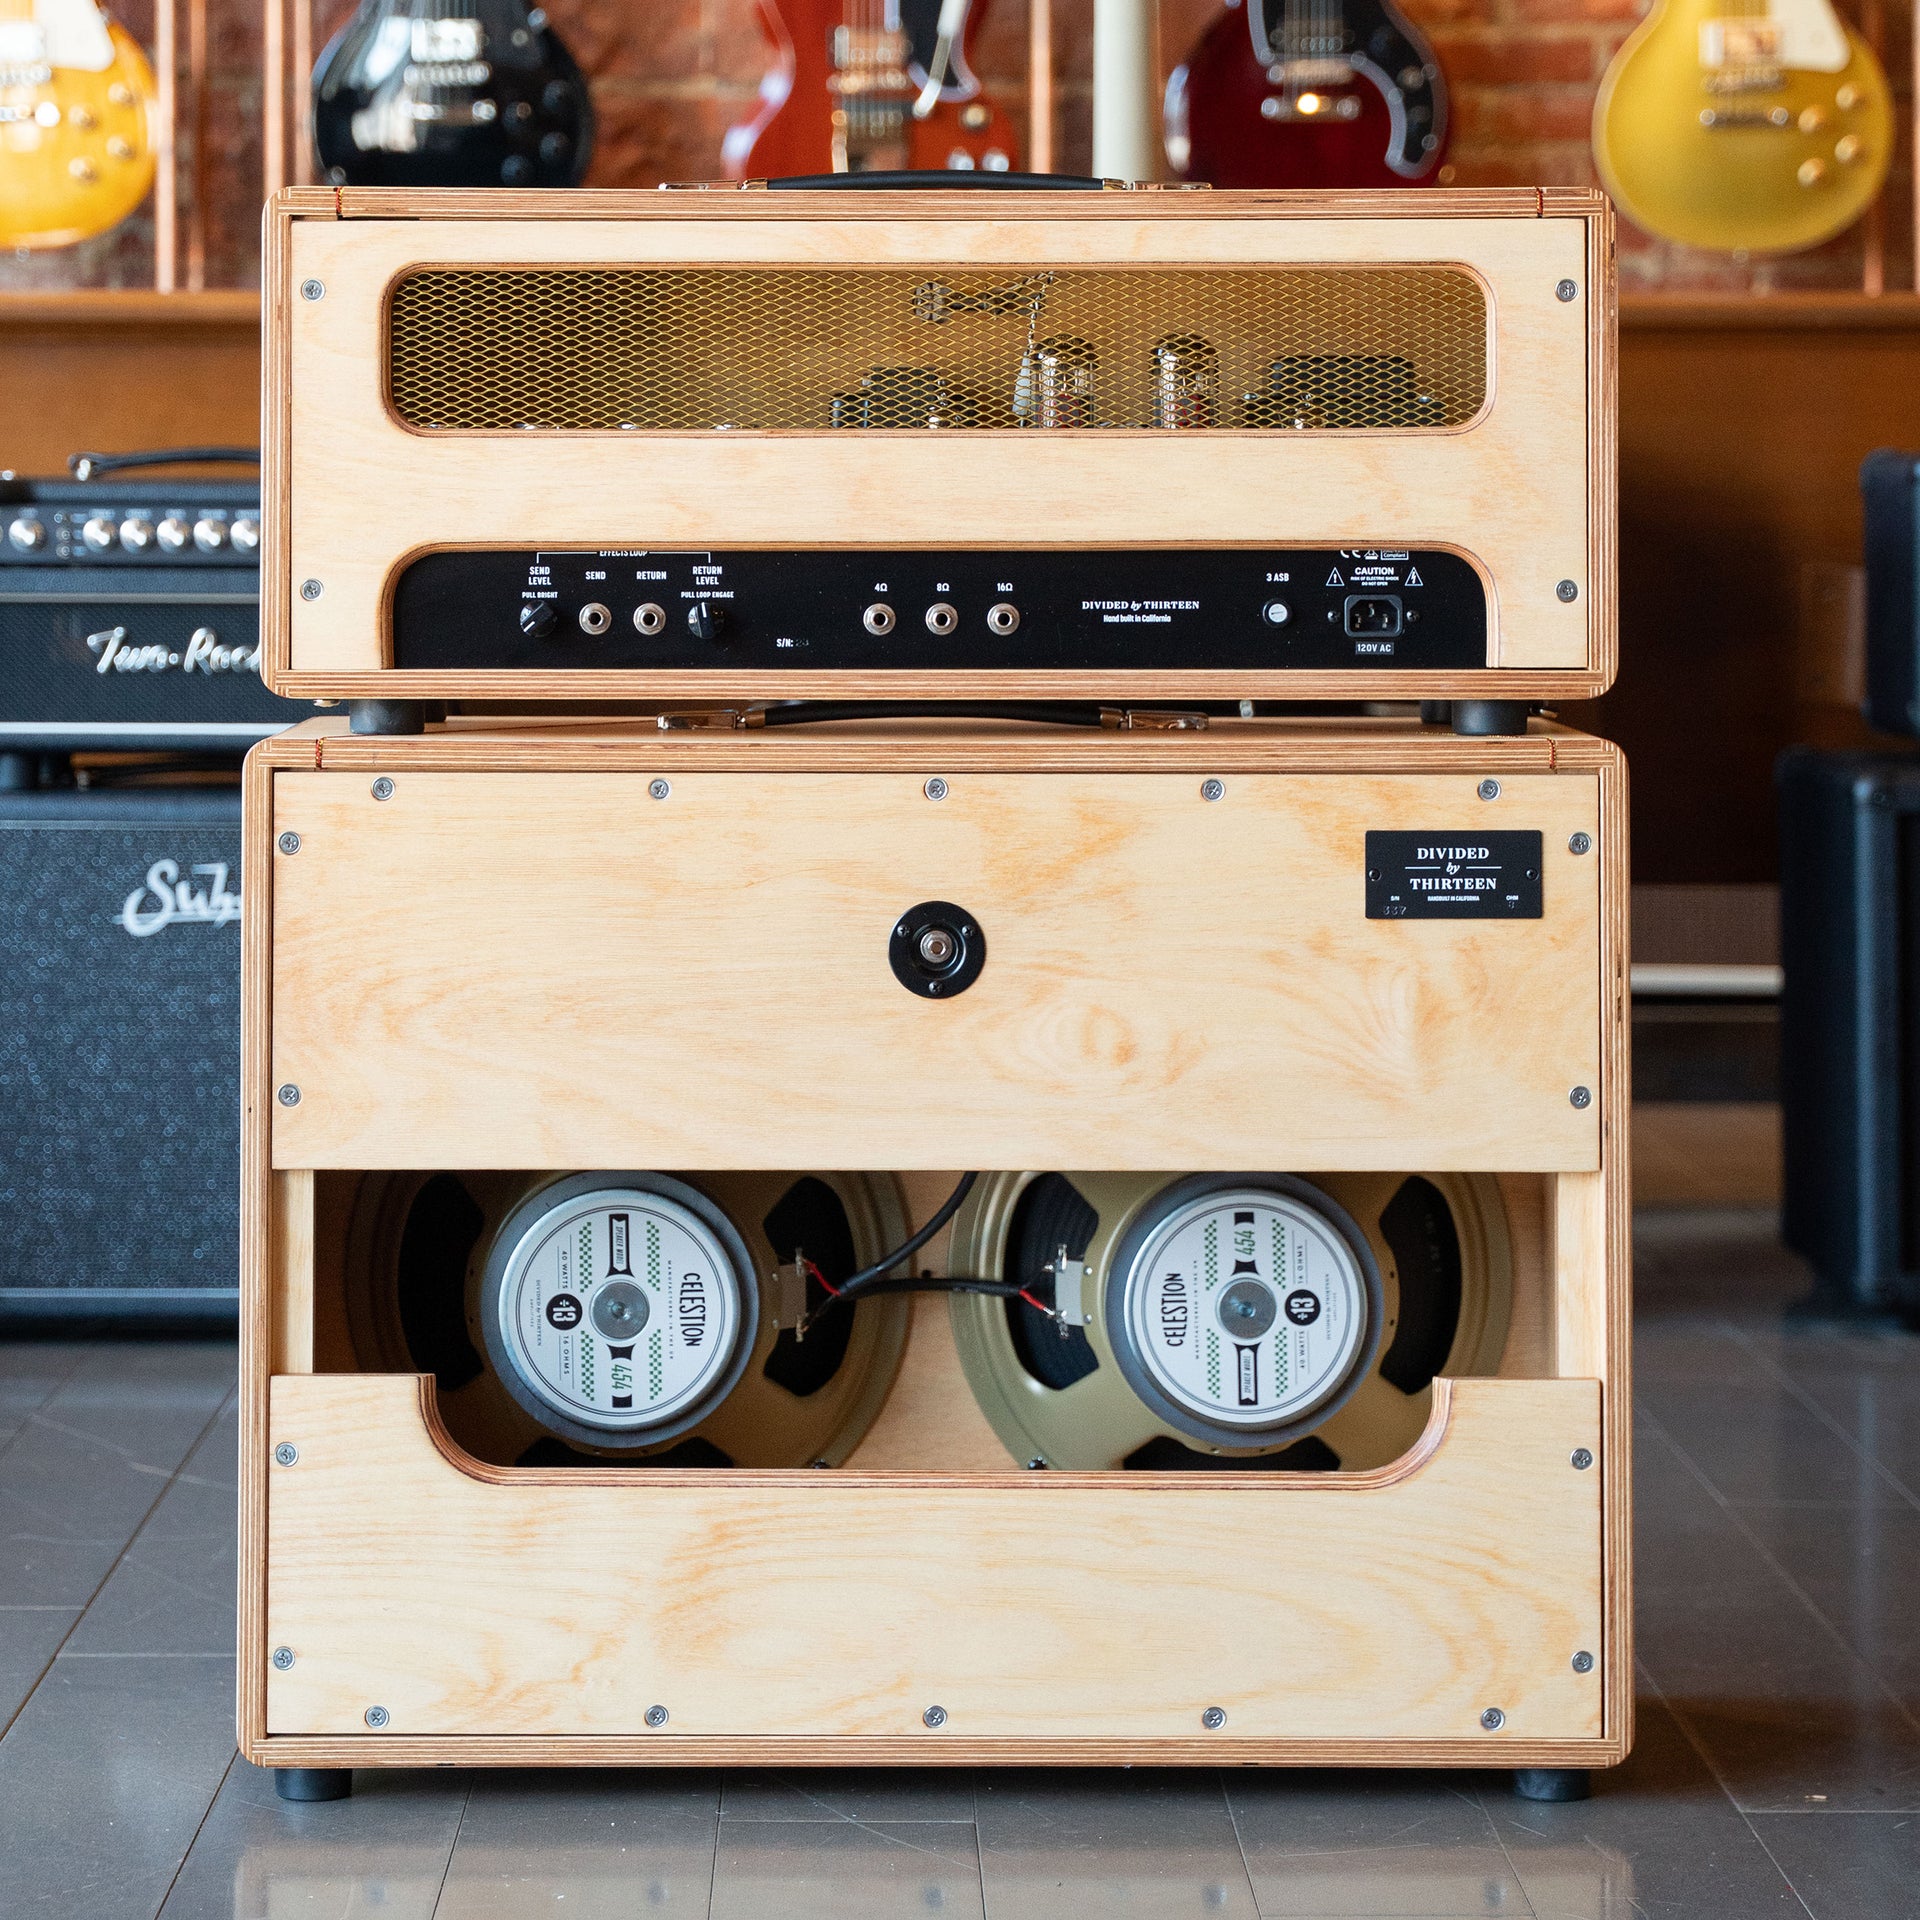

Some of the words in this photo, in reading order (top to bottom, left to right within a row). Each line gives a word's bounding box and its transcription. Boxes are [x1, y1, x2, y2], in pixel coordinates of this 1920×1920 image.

[529, 566, 550, 575] SEND
[585, 571, 606, 580] SEND
[636, 571, 667, 580] RETURN
[692, 566, 722, 575] RETURN
[1354, 567, 1394, 575] CAUTION
[528, 576, 551, 585] LEVEL
[696, 576, 719, 585] LEVEL
[1266, 573, 1273, 582] 3
[1273, 573, 1290, 582] ASB
[1082, 601, 1129, 610] DIVIDED
[1130, 600, 1142, 611] by
[1143, 601, 1199, 609] THIRTEEN
[1103, 614, 1119, 623] Hand
[1120, 614, 1134, 623] built
[1135, 614, 1141, 623] in
[1141, 614, 1171, 623] California
[776, 637, 794, 648] S/N:
[1357, 643, 1378, 652] 120V
[1379, 643, 1391, 652] AC
[87, 626, 260, 675] Two-Roc
[1417, 848, 1490, 860] DIVIDED
[1446, 862, 1460, 875] by
[1410, 878, 1497, 890] THIRTEEN
[111, 859, 241, 937] Suh
[1234, 1230, 1255, 1255] 454
[561, 1250, 568, 1260] 40
[679, 1272, 706, 1346] CELESTION
[1161, 1273, 1188, 1346] CELESTION
[563, 1335, 569, 1344] 16
[612, 1364, 632, 1390] 454
